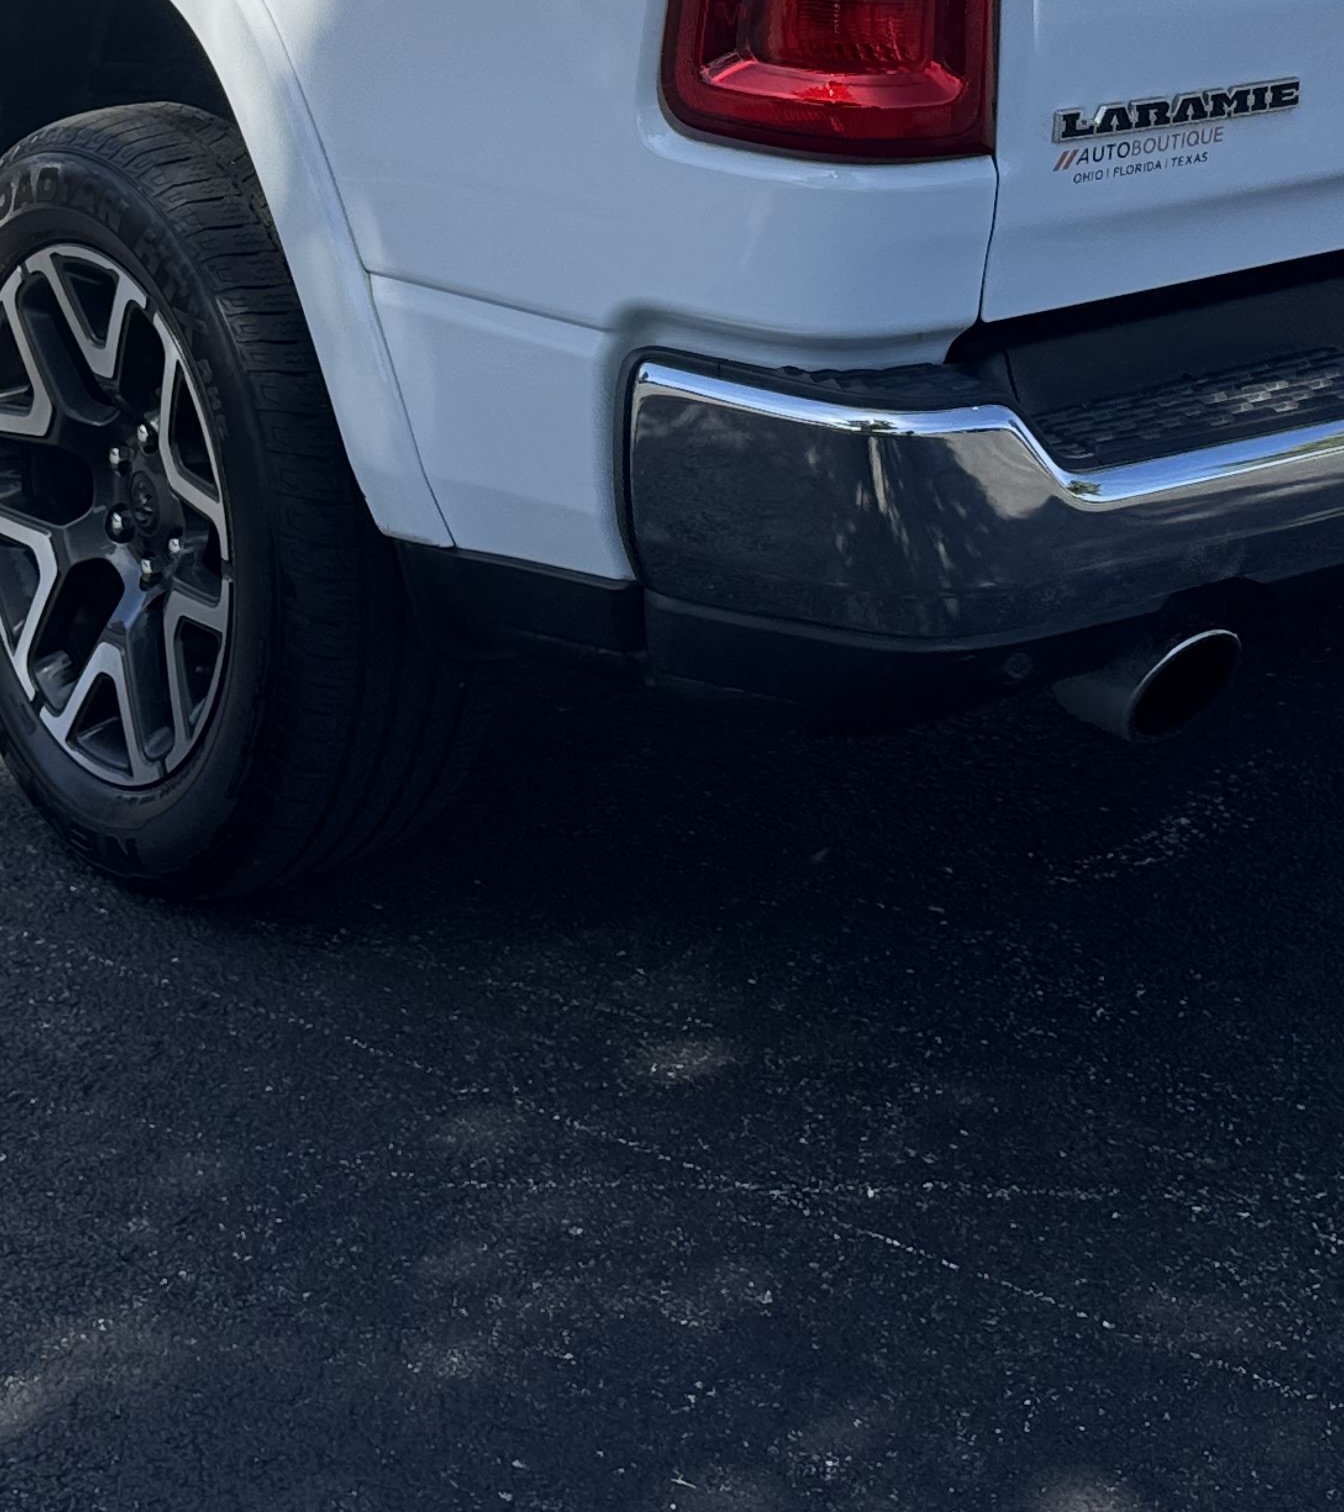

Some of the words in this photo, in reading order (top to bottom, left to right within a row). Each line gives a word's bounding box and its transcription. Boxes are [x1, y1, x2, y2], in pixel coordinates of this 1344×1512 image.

[1051, 75, 1301, 143] LARAMIE
[1072, 168, 1104, 184] OHIO
[1112, 159, 1163, 178] FLORIDA
[1170, 151, 1209, 167] TEXAS
